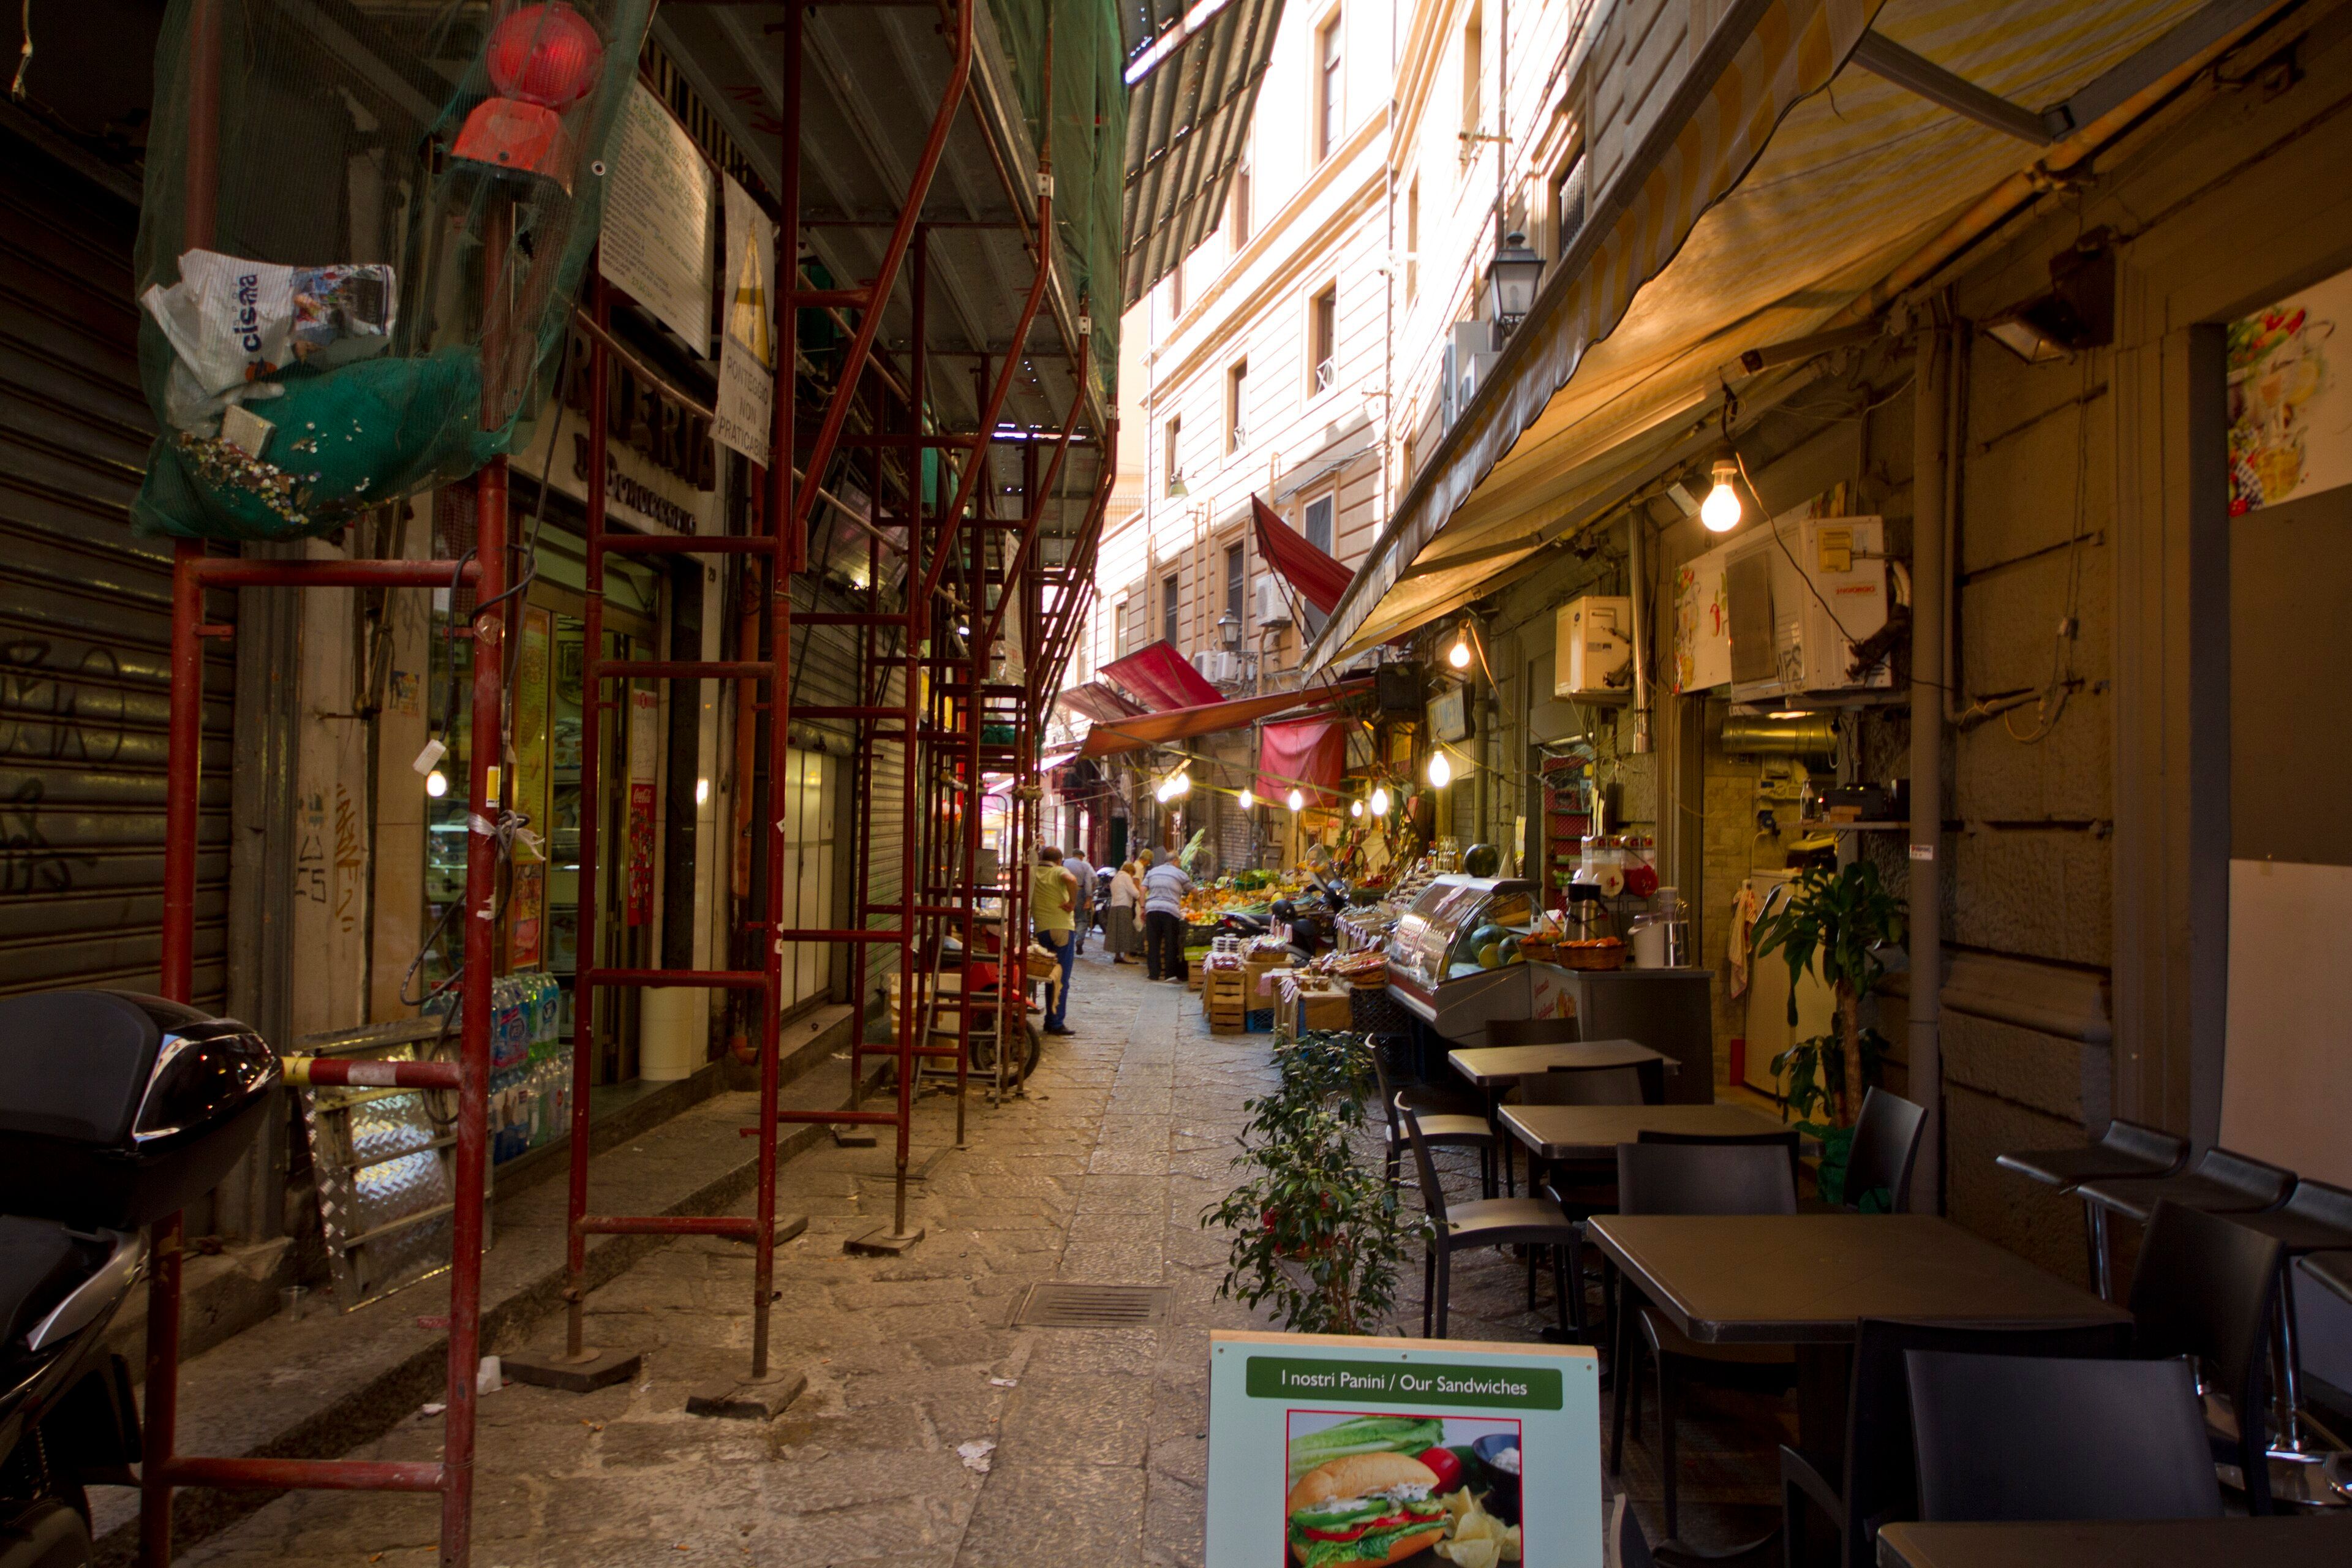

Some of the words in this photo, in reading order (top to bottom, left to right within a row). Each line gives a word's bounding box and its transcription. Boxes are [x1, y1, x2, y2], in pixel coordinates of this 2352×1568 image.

[726, 355, 768, 405] PONTEGGIO
[739, 397, 756, 425] NON
[718, 415, 768, 461] PRATICABILE
[1281, 1369, 1286, 1385] I
[1291, 1373, 1335, 1387] nostri
[1340, 1371, 1385, 1389] Panini
[1400, 1374, 1433, 1392] Our
[1437, 1376, 1528, 1396] Sandwiches
